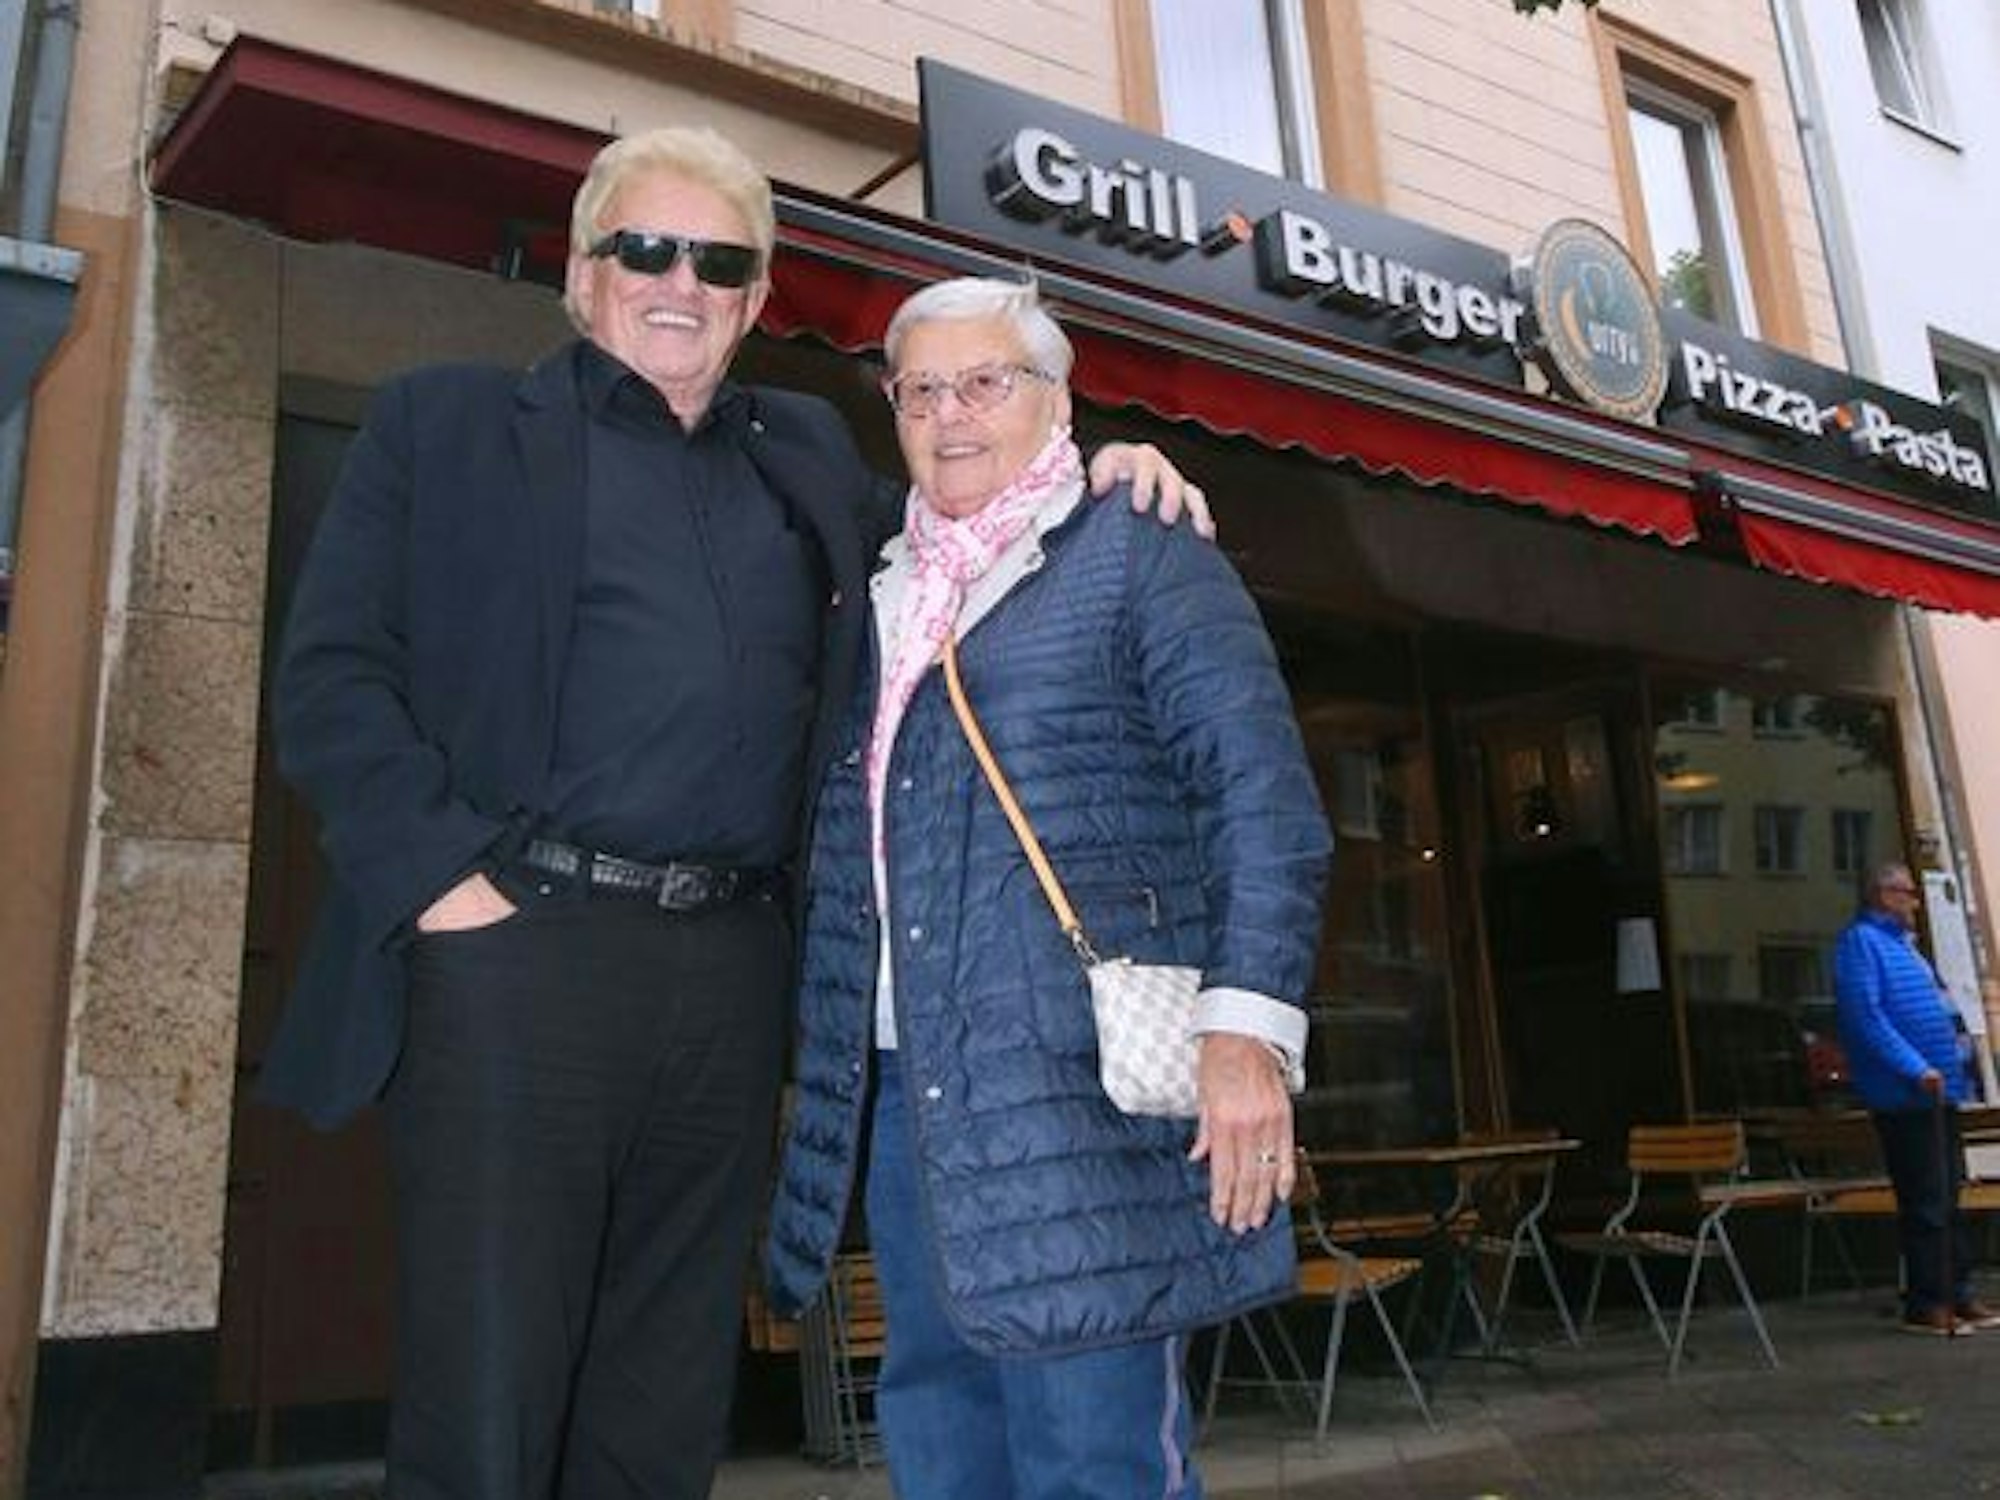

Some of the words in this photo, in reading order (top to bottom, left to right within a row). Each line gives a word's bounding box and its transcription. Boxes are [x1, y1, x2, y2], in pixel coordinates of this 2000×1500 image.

[1013, 128, 1199, 246] Grill
[1281, 210, 1525, 343] Burger
[1681, 340, 1823, 436] Pizza
[1861, 402, 1989, 490] Pasta
